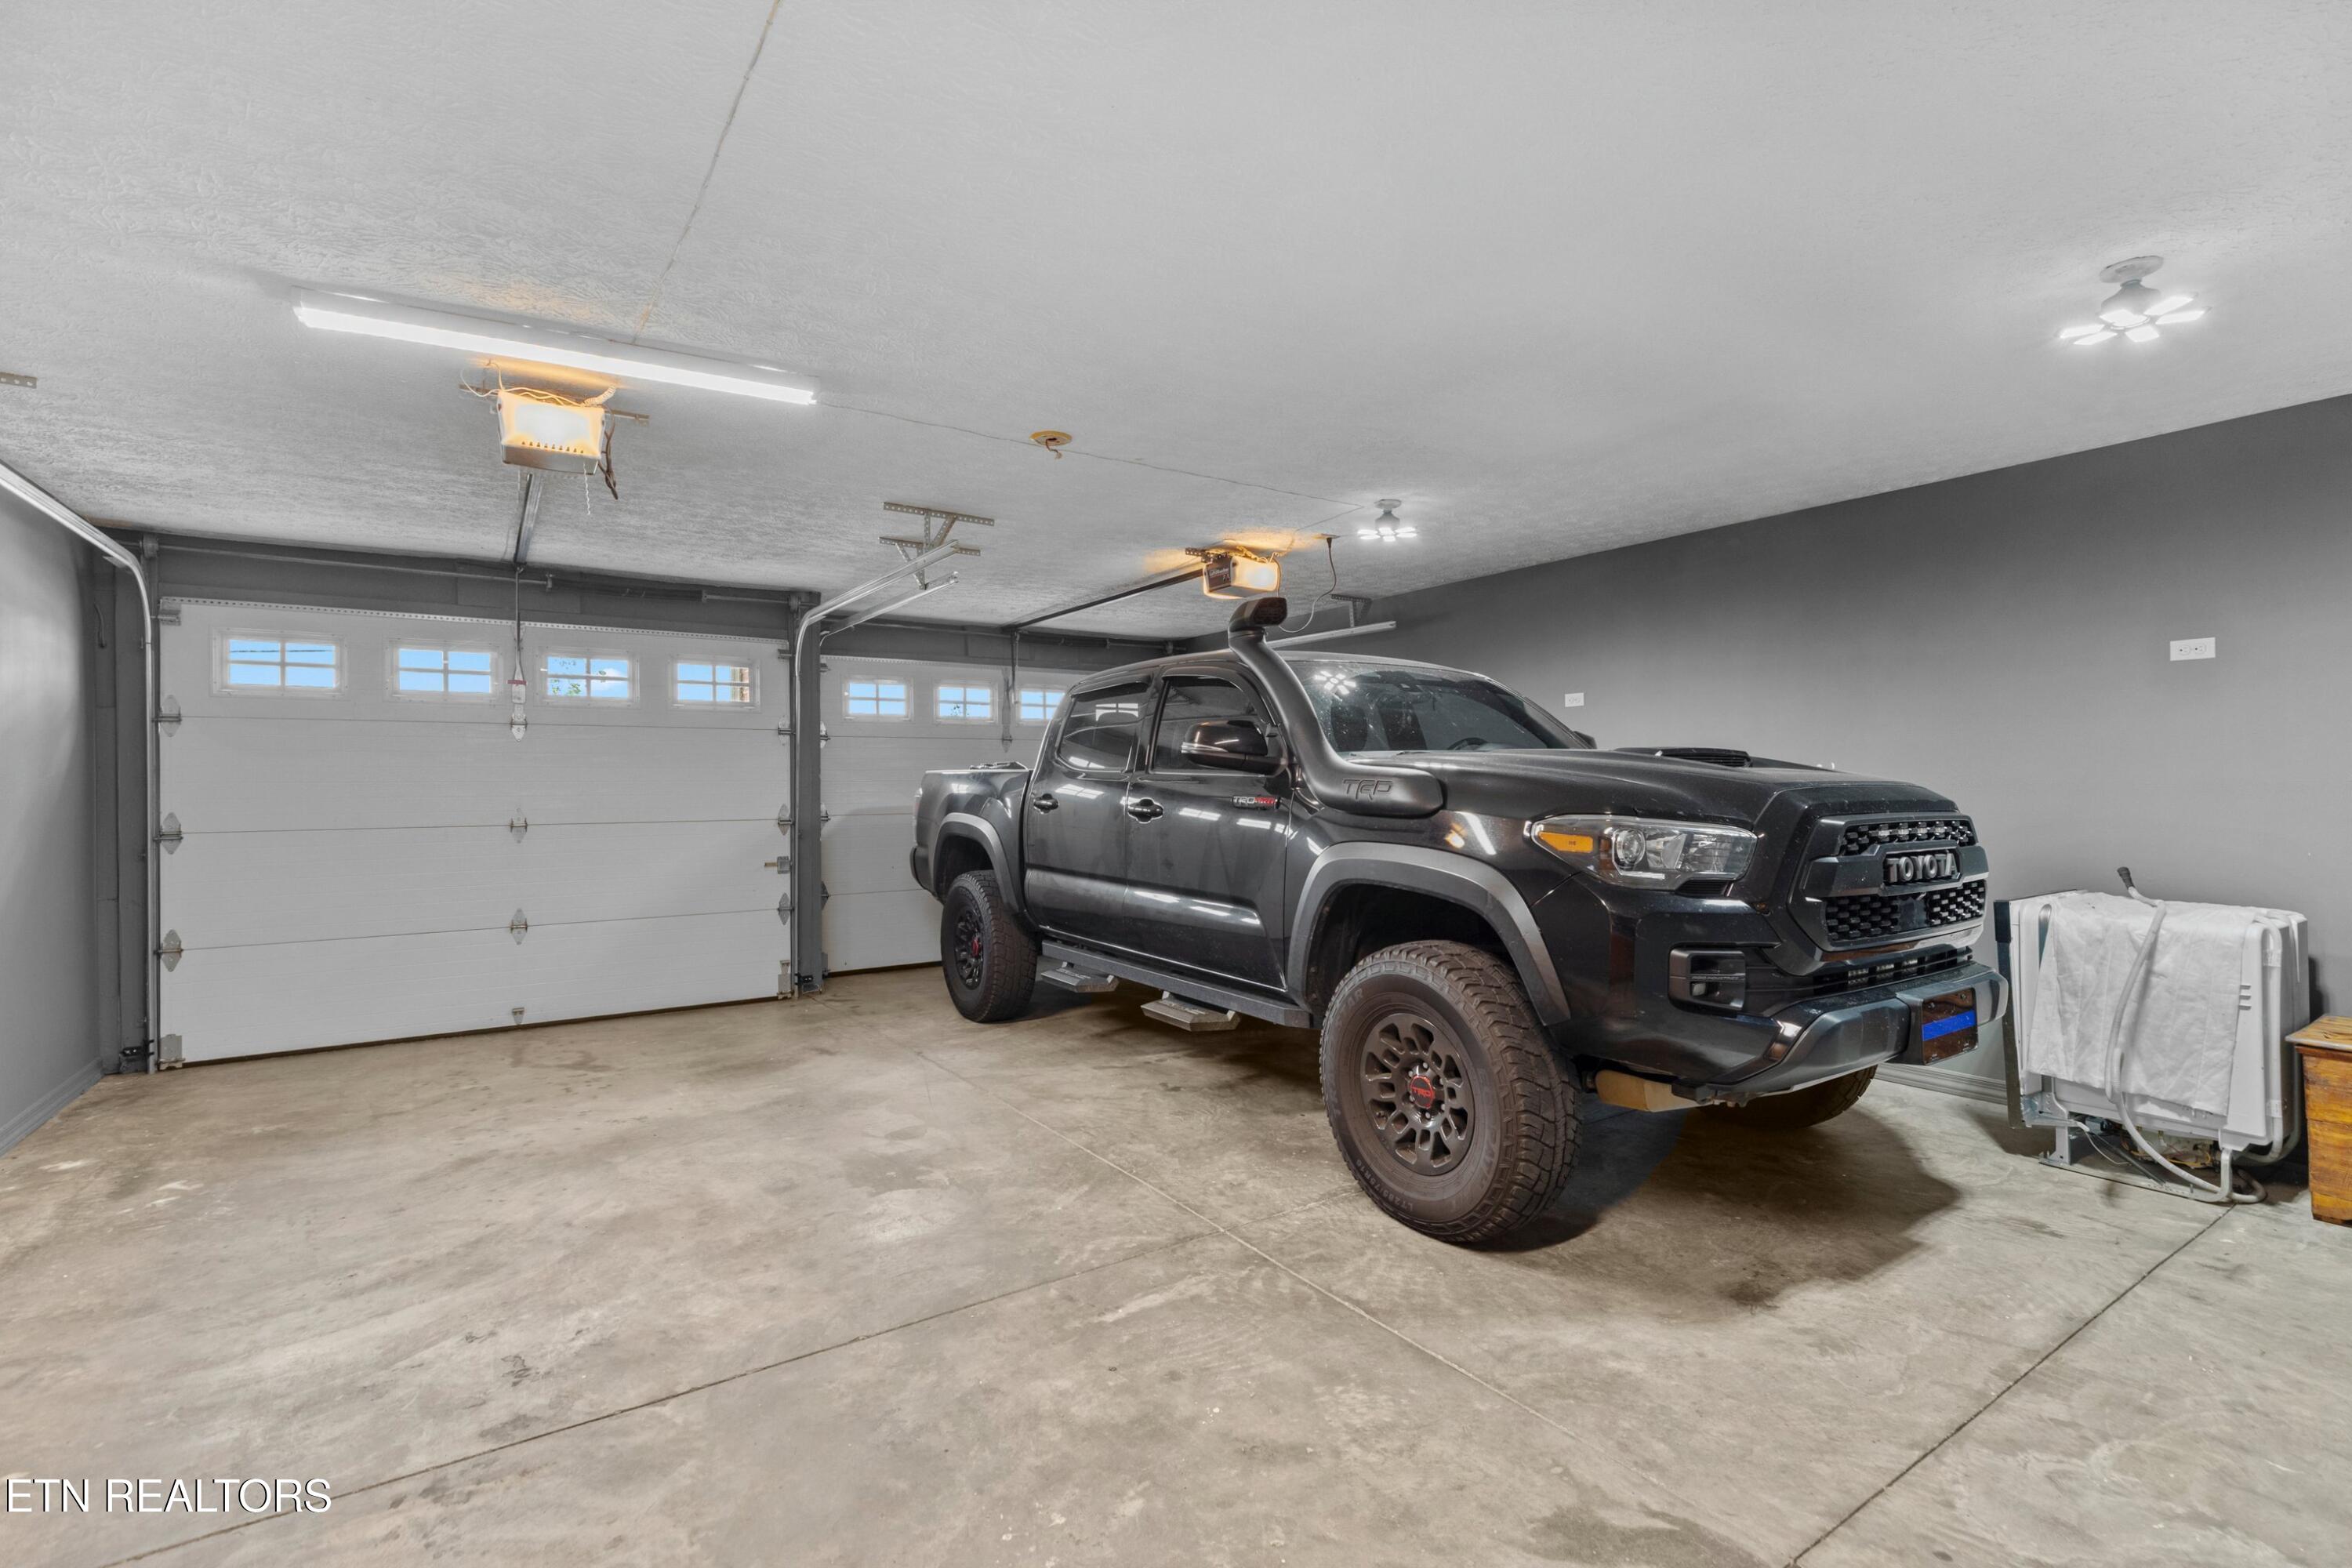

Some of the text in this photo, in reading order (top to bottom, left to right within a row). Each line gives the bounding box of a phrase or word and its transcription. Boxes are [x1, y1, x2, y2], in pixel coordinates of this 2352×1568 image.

[1342, 779, 1392, 800] TRD
[1886, 852, 1958, 883] TOYOTA
[1412, 1087, 1431, 1098] TRD
